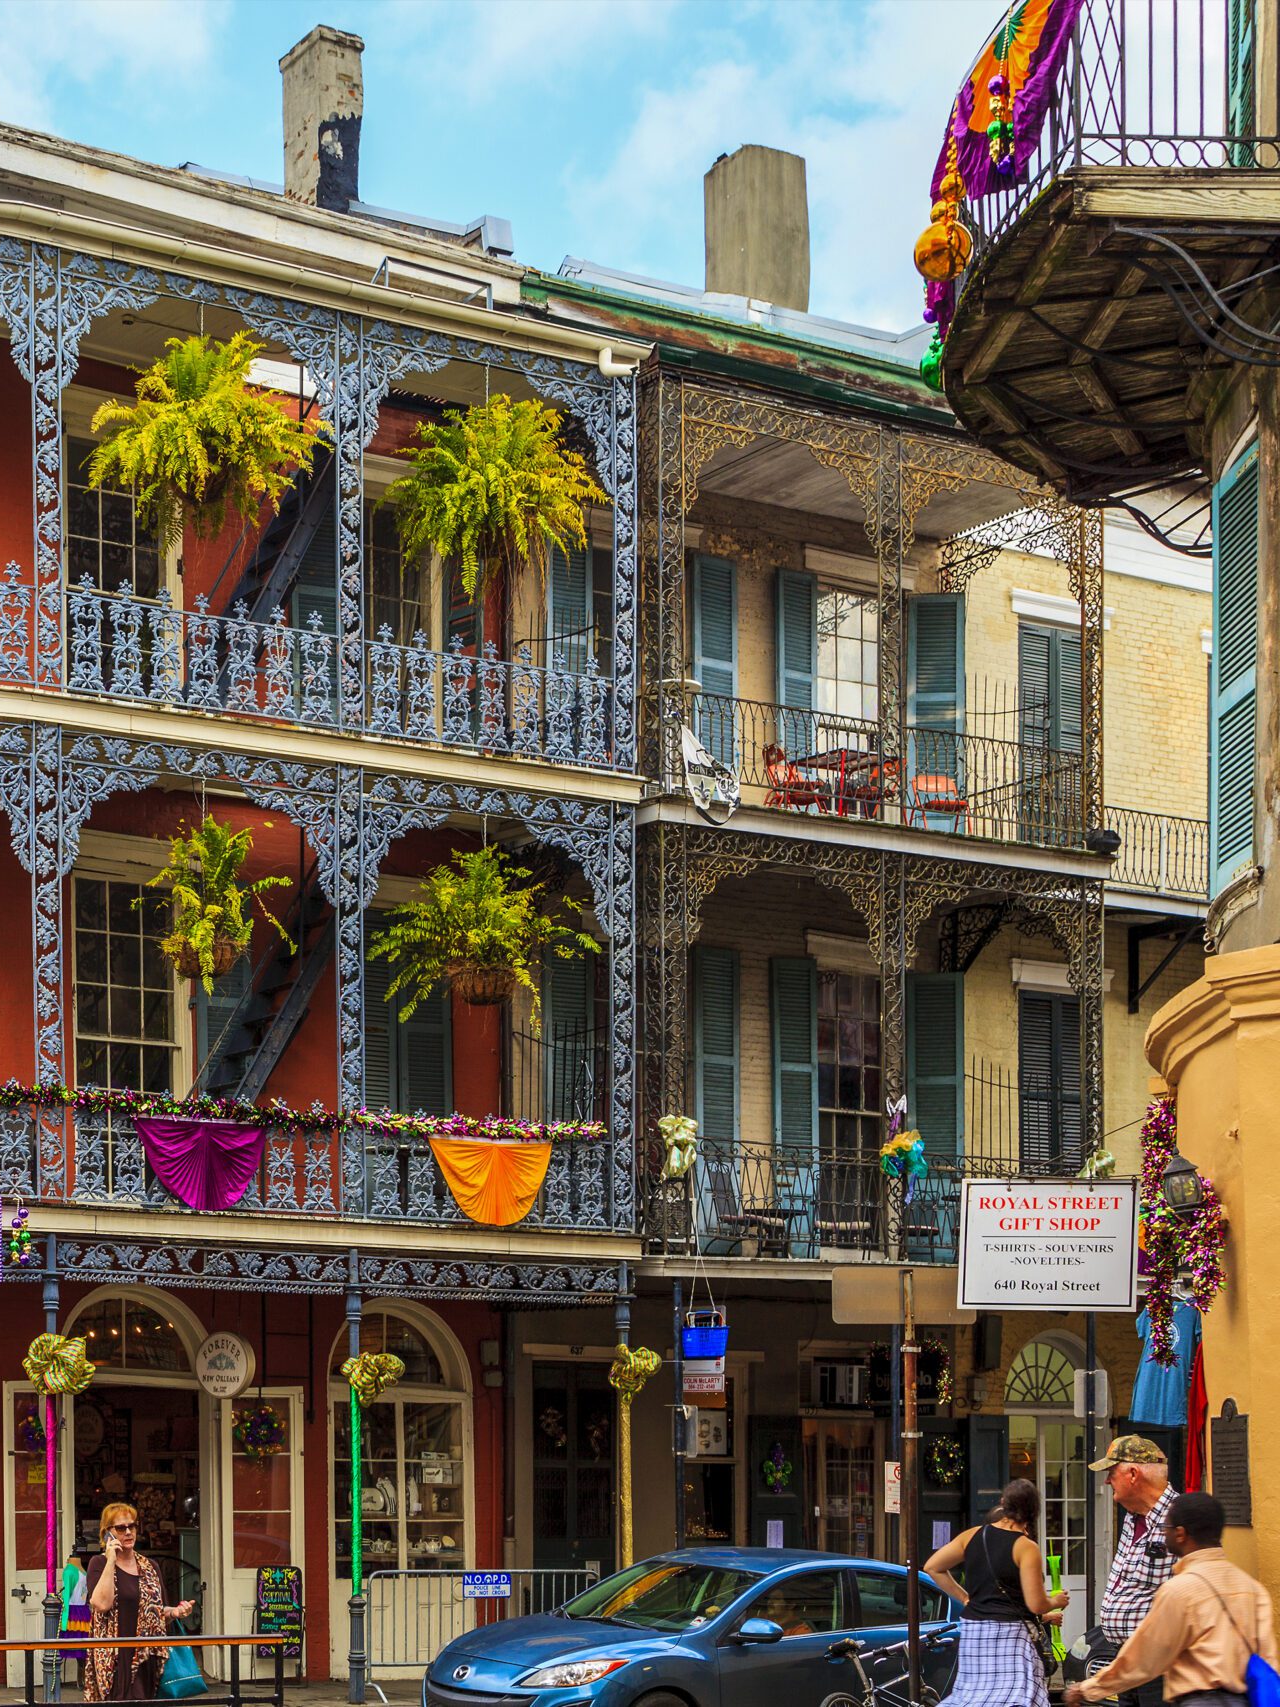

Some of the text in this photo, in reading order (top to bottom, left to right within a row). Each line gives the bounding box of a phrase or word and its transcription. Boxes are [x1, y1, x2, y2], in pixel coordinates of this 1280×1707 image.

[979, 1197, 1123, 1210] ROYAL STREET
[999, 1217, 1101, 1231] GIFT SHOP
[983, 1243, 1036, 1253] T-SHIRTS
[1045, 1244, 1114, 1253] SOUVENIRS
[994, 1279, 1101, 1293] 640 Royal Street
[202, 1339, 240, 1361] FOREVER
